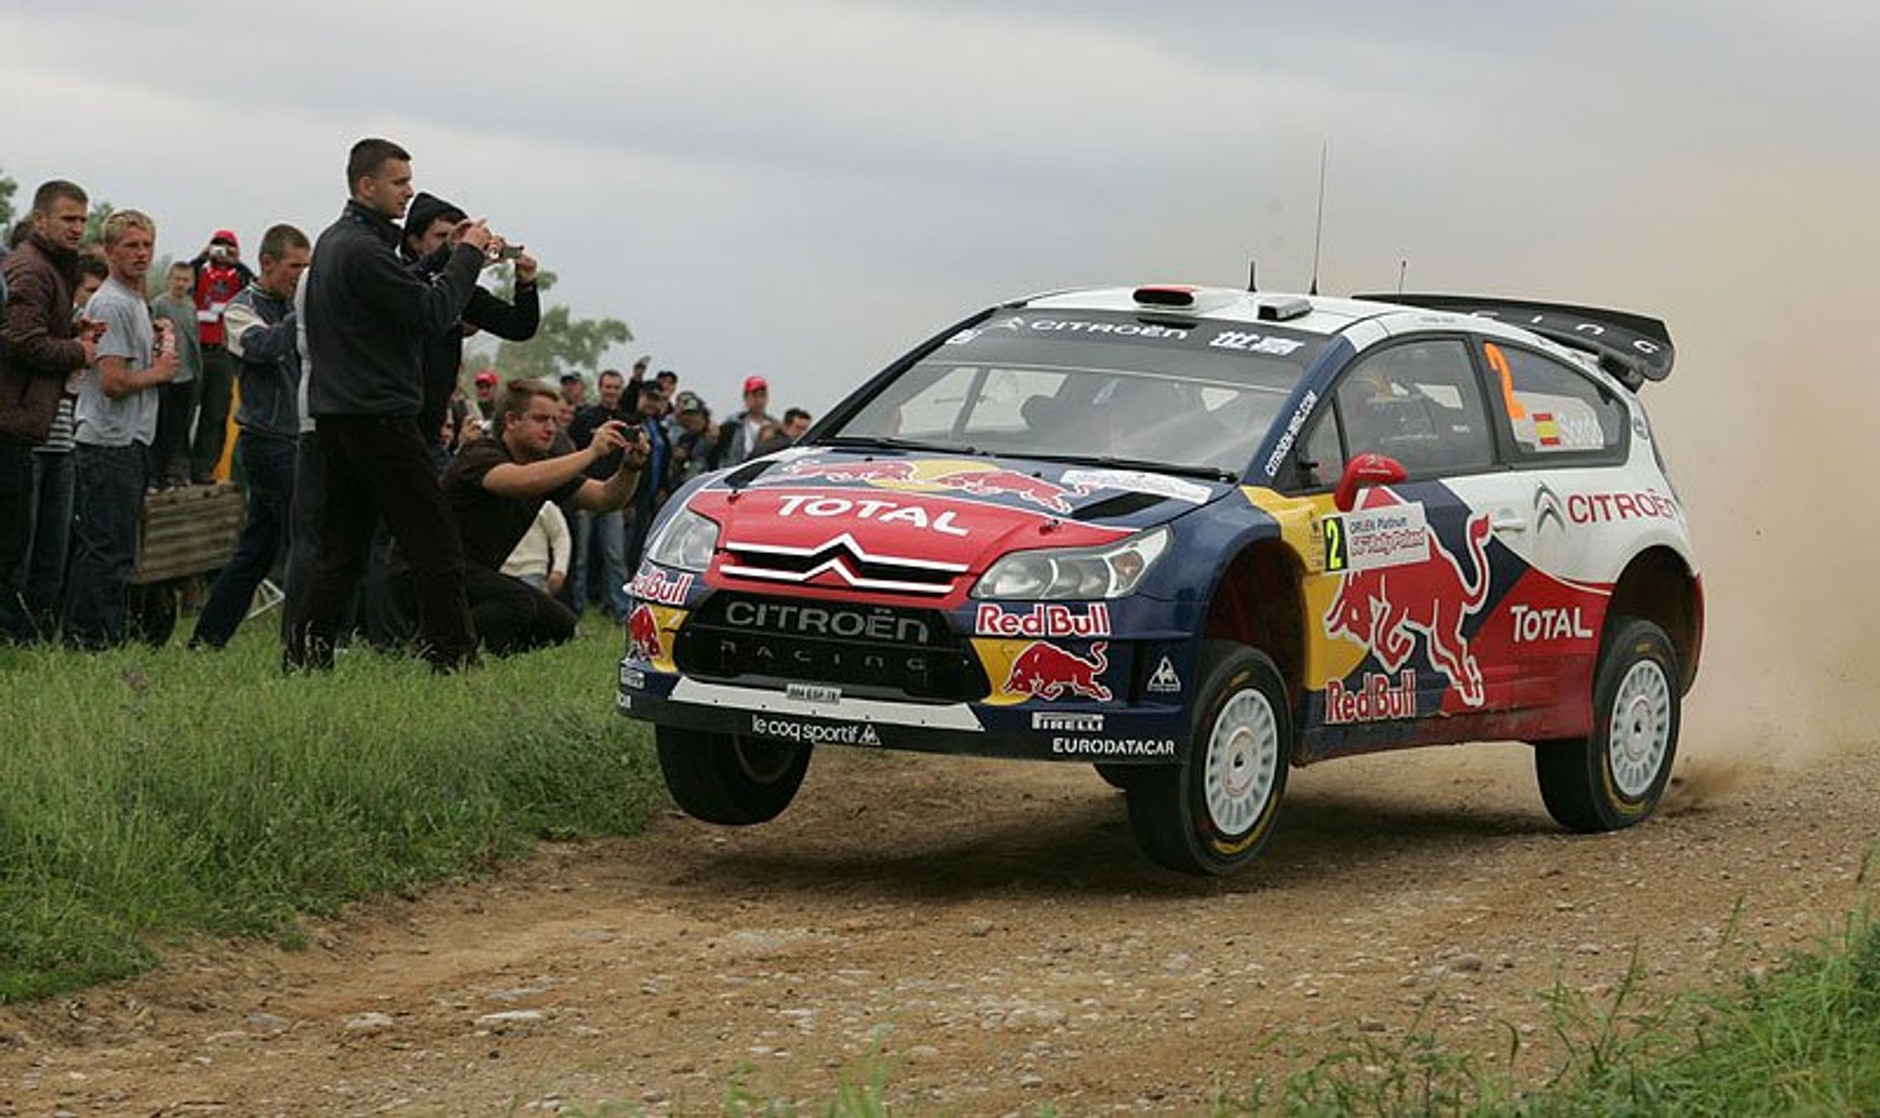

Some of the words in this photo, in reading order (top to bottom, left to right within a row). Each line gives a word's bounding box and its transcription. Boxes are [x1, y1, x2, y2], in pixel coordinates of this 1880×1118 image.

[1484, 343, 1525, 420] 2
[778, 495, 969, 536] TOTAL
[1326, 519, 1342, 569] 2
[976, 602, 1045, 636] Red
[1047, 602, 1111, 636] Bull
[1511, 605, 1594, 643] TOTAL
[752, 714, 767, 734] le
[768, 721, 800, 742] coq
[801, 724, 859, 744] sportif
[1031, 711, 1105, 731] PIRELLI
[1052, 737, 1175, 755] EURODATACAR
